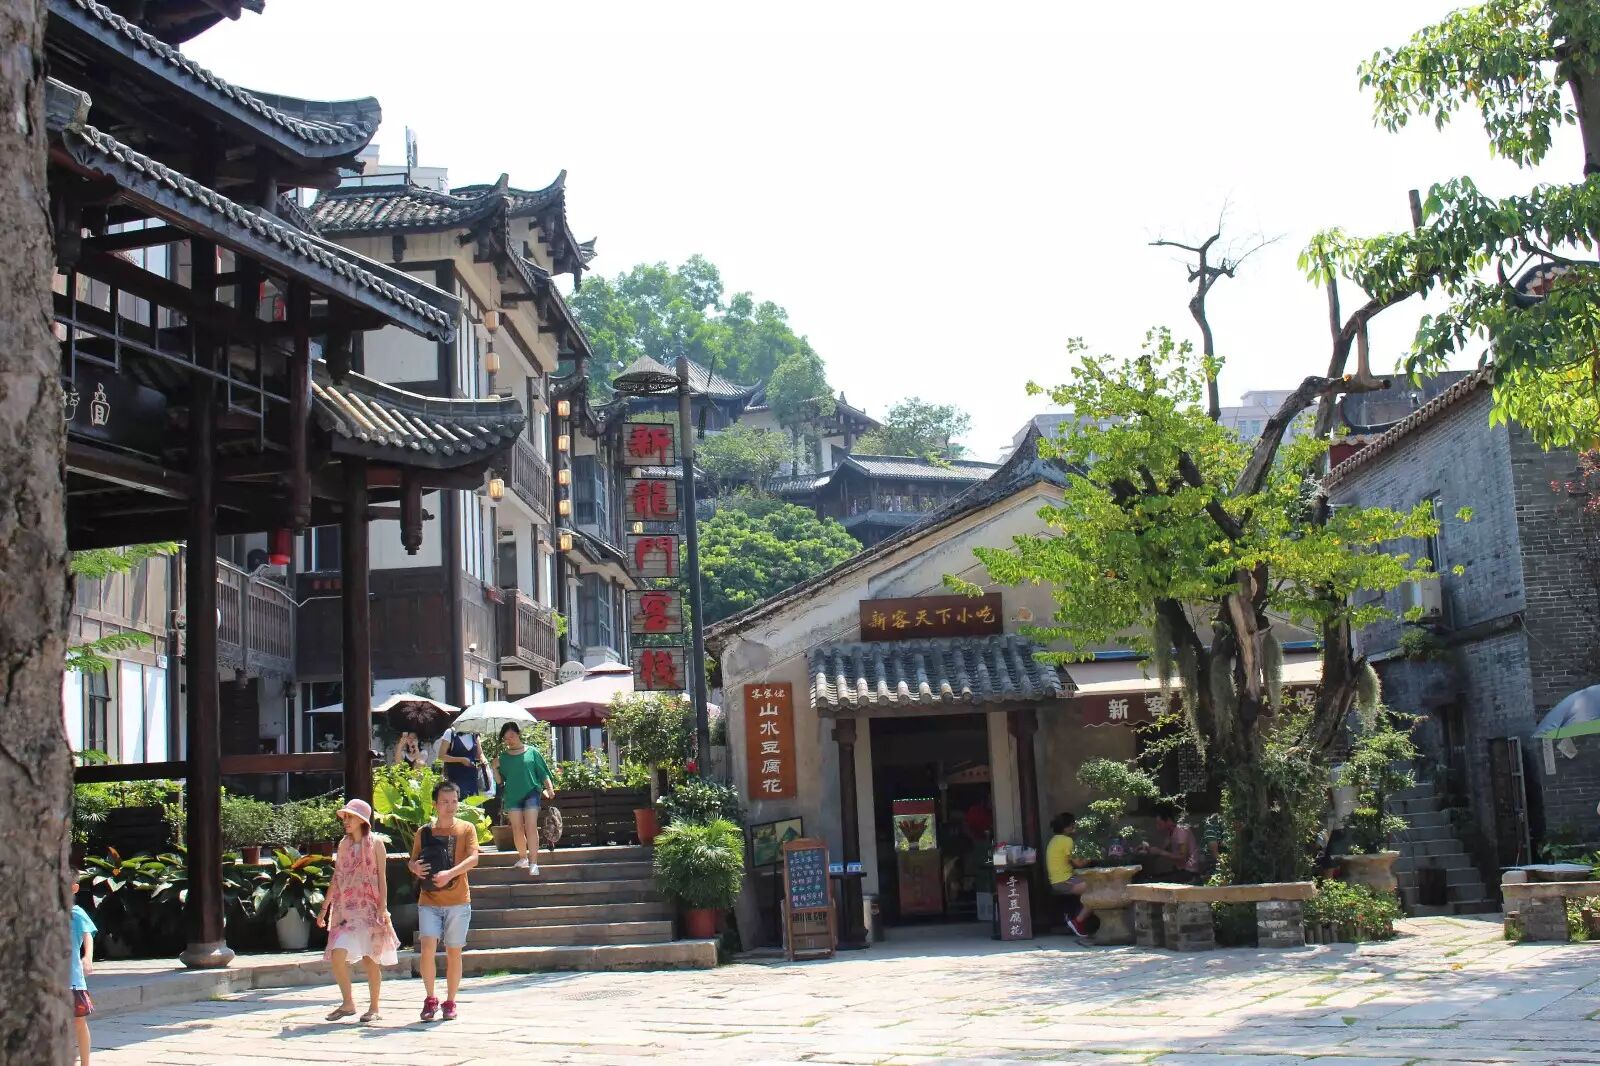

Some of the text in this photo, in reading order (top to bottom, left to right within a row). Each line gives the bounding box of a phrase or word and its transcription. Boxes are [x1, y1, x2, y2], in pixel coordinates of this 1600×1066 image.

[868, 605, 995, 630] 新客天下小吃
[759, 702, 782, 793] 山水豆腐花
[1006, 875, 1023, 936] 手工豆腐花
